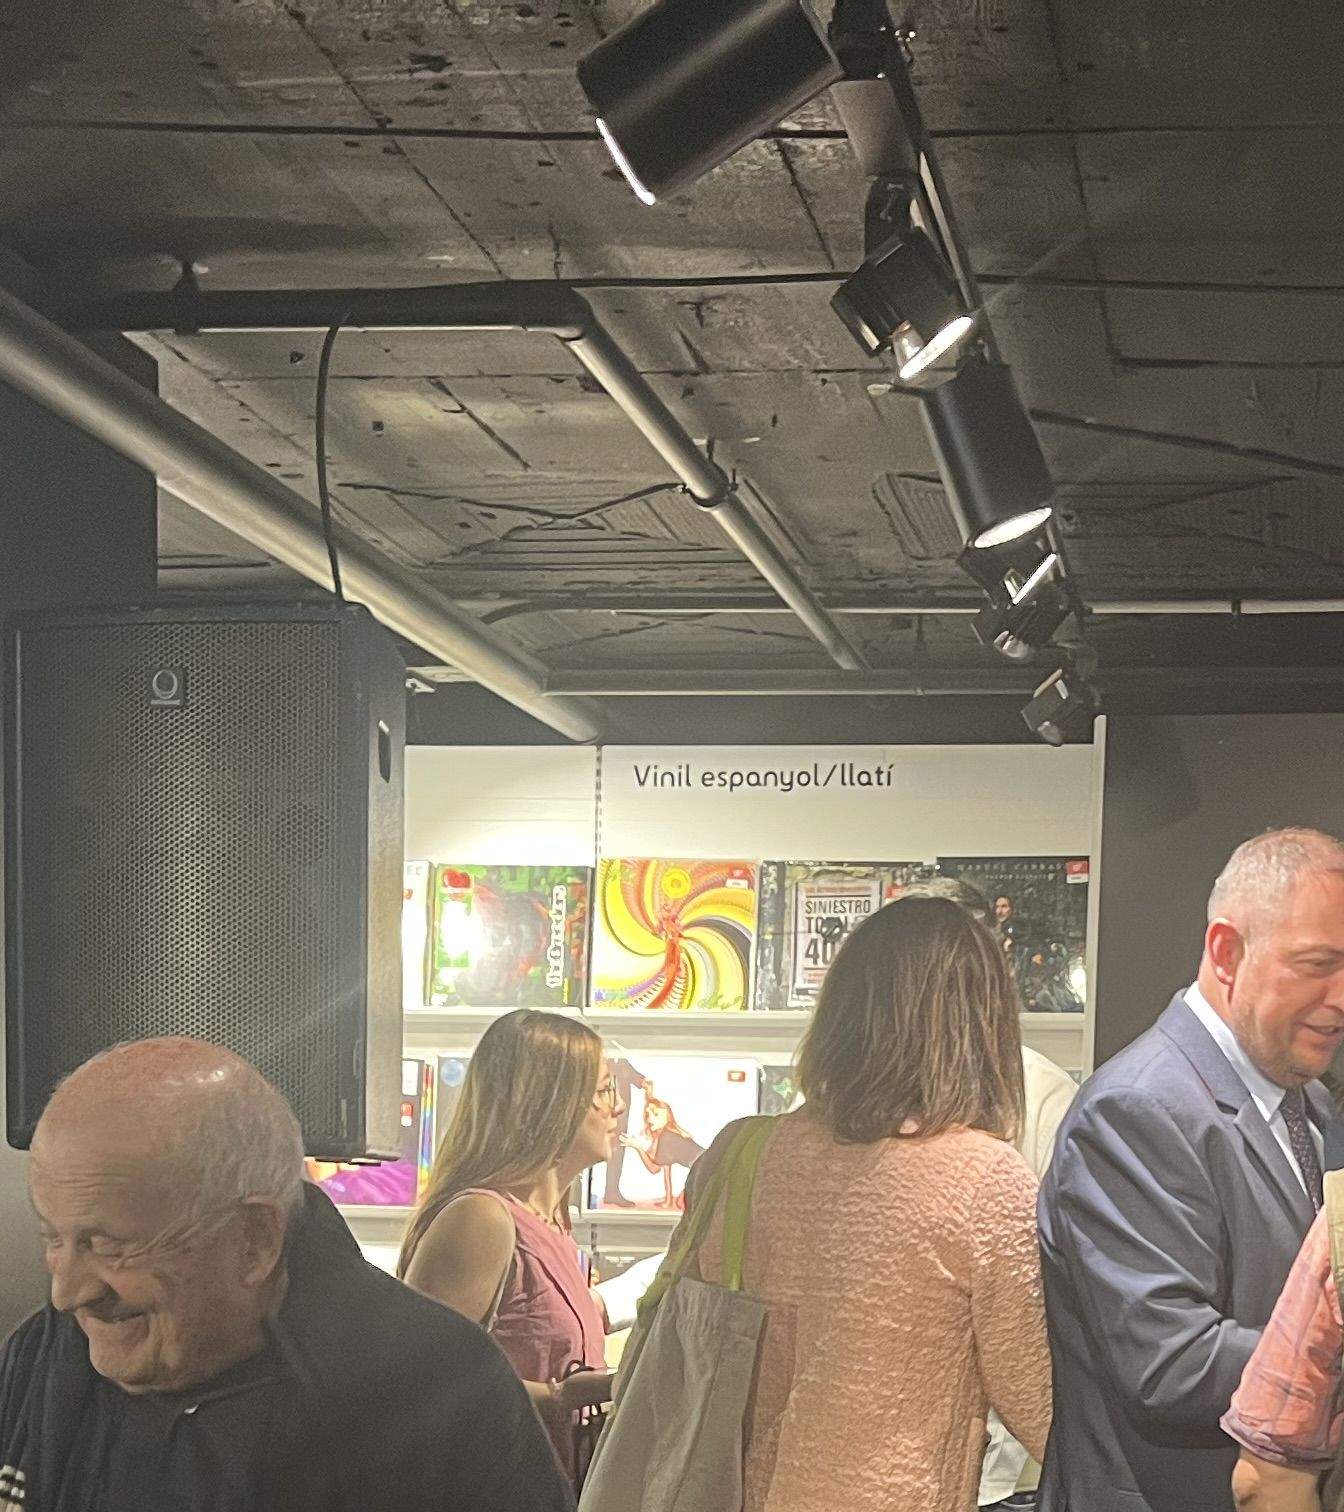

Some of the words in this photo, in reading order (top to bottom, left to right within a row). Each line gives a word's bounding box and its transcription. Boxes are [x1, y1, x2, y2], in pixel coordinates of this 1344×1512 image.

[634, 764, 691, 787] Vinil
[701, 763, 895, 792] espanyol/llatí
[805, 900, 871, 914] SINIESTRO
